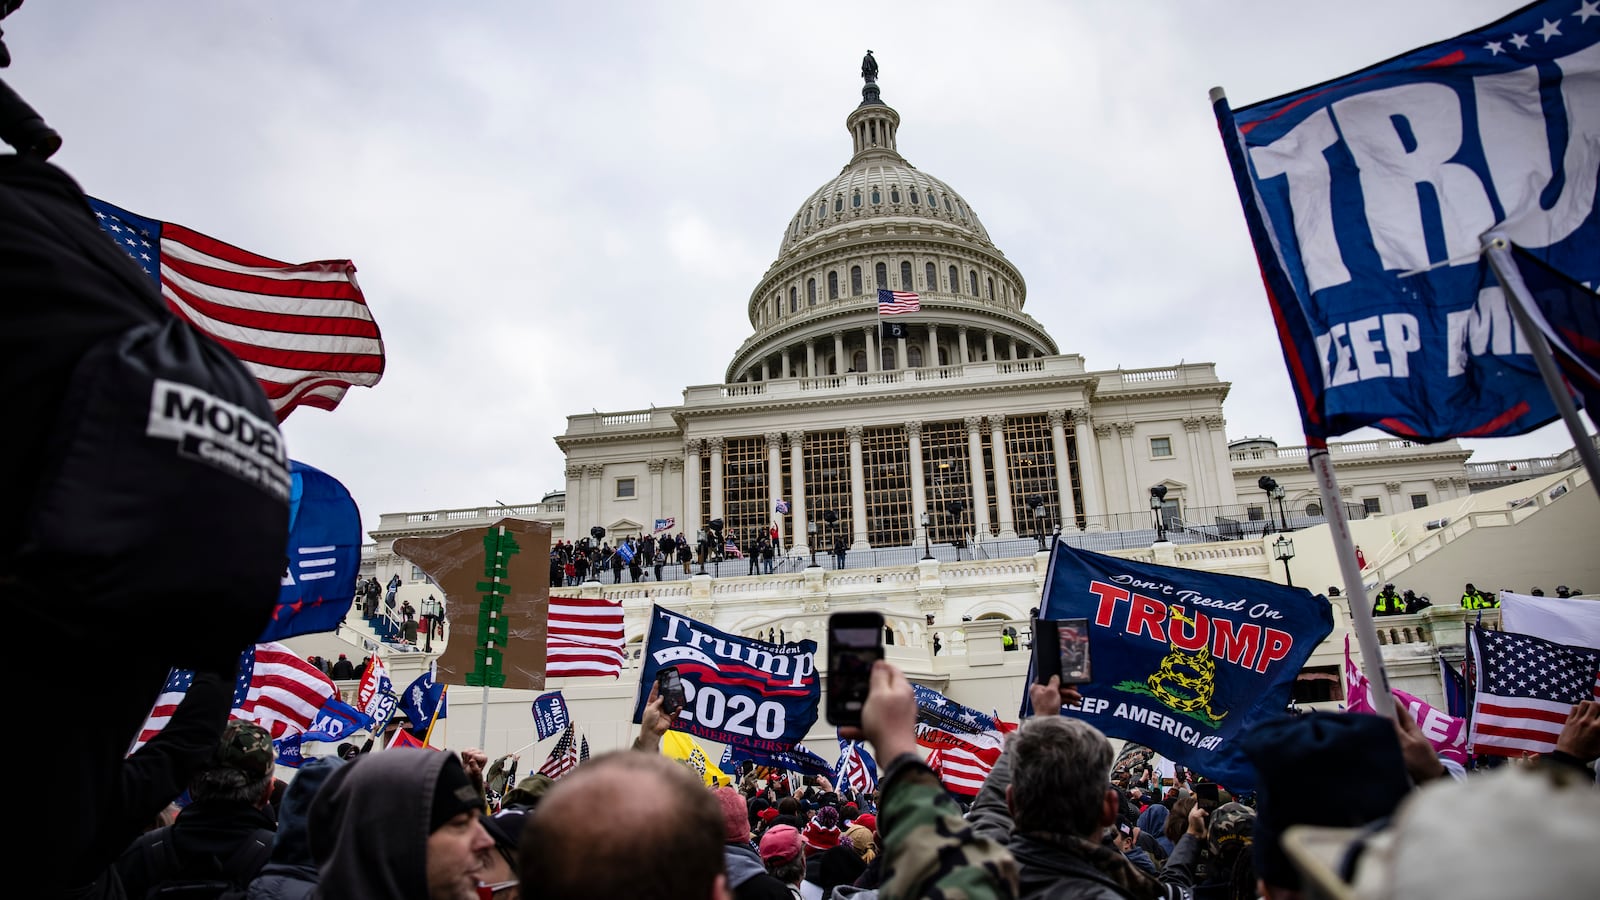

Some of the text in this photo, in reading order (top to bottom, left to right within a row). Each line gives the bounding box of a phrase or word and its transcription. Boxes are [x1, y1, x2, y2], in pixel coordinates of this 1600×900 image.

[1109, 574, 1283, 620] Don't Tread On
[660, 611, 814, 688] Trump
[1089, 580, 1294, 674] TRUMP
[691, 723, 751, 746] AMERICA
[753, 739, 793, 753] FIRST
[1113, 702, 1200, 748] AMERICA
